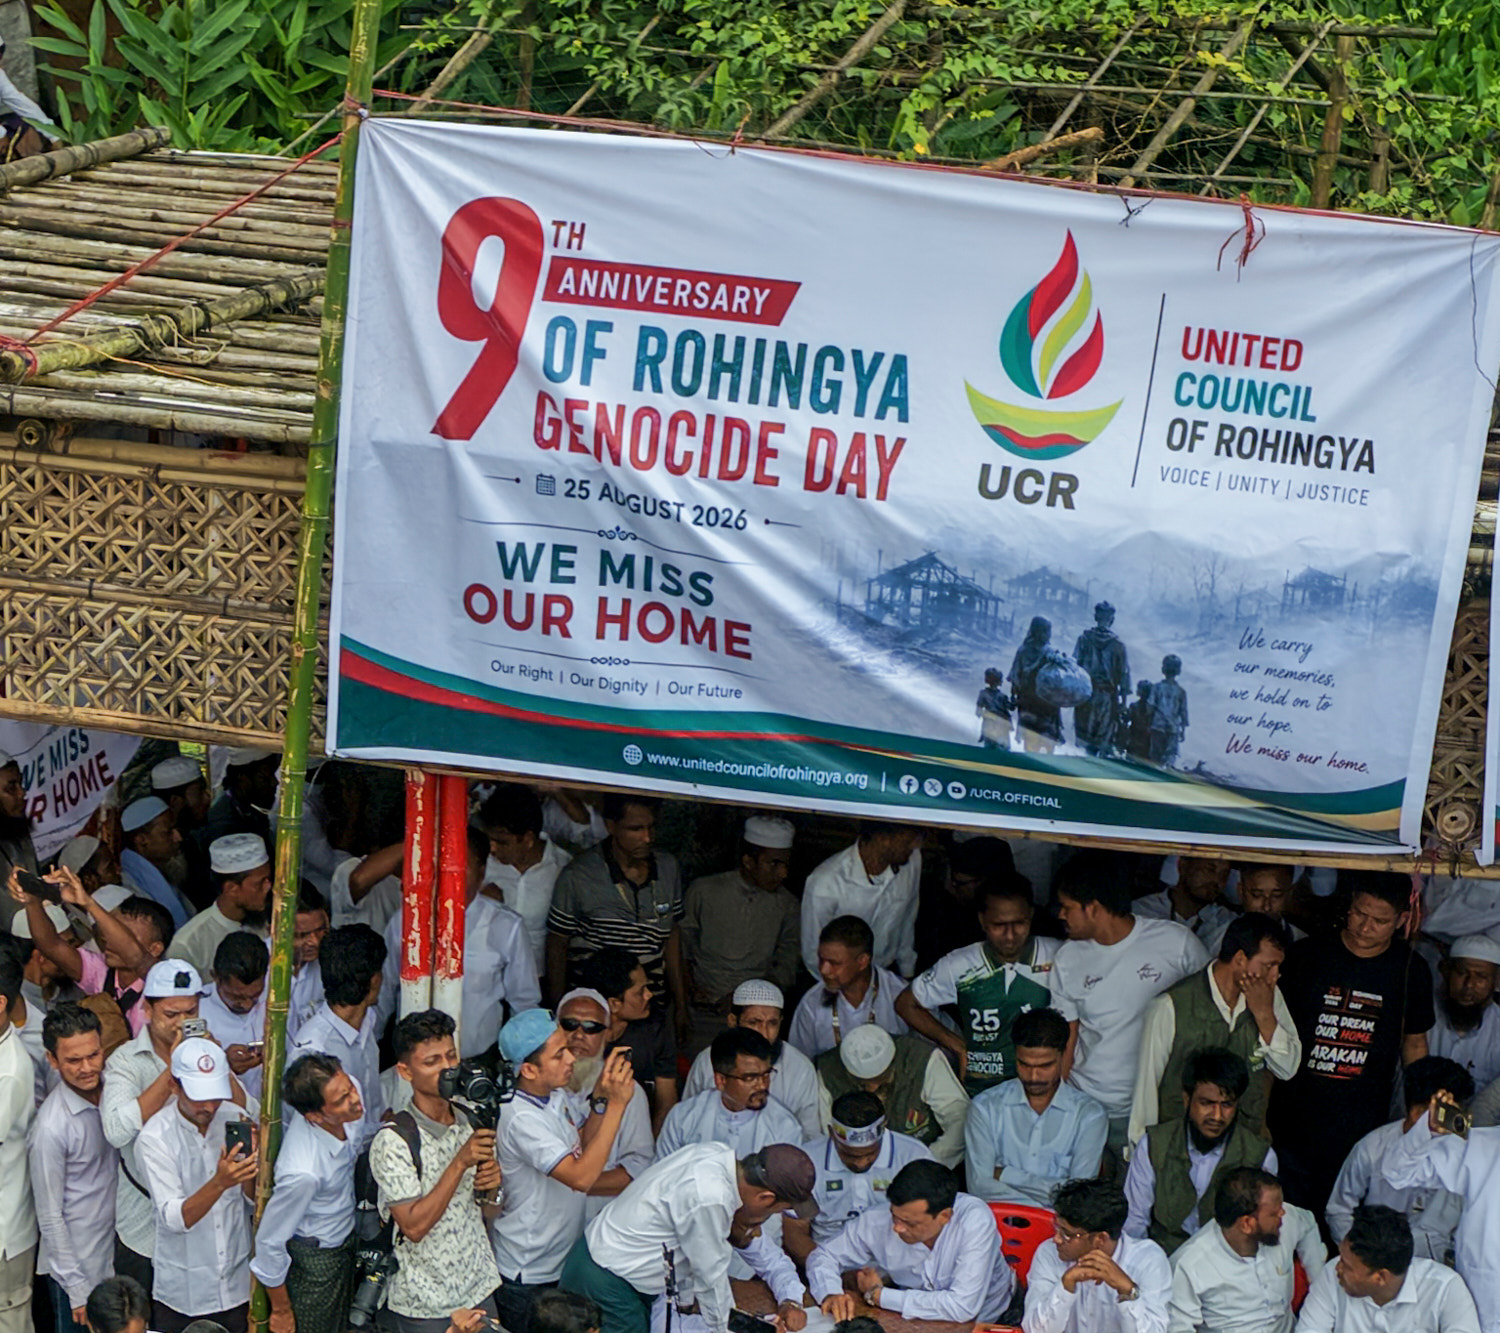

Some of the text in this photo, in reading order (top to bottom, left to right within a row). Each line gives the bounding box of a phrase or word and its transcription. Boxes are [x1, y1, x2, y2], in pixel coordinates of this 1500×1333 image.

[551, 220, 586, 250] TH
[557, 267, 770, 315] ANNIVERSARY
[430, 196, 545, 441] 9
[542, 316, 909, 424] OF ROHINGYA
[1181, 325, 1304, 371] UNITED
[1174, 371, 1317, 423] COUNCIL
[532, 390, 907, 501] GENOCIDE DAY
[1165, 417, 1376, 474] OF ROHINGYA
[564, 478, 748, 530] 25 AUGUST 2026
[977, 463, 1080, 510] UCR
[1159, 465, 1370, 507] VOICE UNITY JUSTICE
[496, 541, 714, 607] WE MISS
[463, 583, 752, 661] OUR HOME
[1239, 627, 1313, 663] We carry
[490, 660, 743, 700] Our Right Our Dignity Our Future
[1233, 660, 1260, 674] our
[1226, 710, 1253, 725] our
[1229, 685, 1332, 711] we hold on to
[48, 728, 90, 778] MISS
[1225, 732, 1253, 754] We
[1257, 745, 1291, 763] miss
[1296, 749, 1323, 765] our
[52, 751, 116, 819] HOME
[647, 752, 1062, 809] www.unitedcouncilofrohingya.org /UCR.OFFICIAL
[970, 1008, 1000, 1031] 25
[1315, 1025, 1339, 1039] OUR
[1318, 1013, 1375, 1032] OUR DREAM
[1310, 1044, 1368, 1065] ARAKAN
